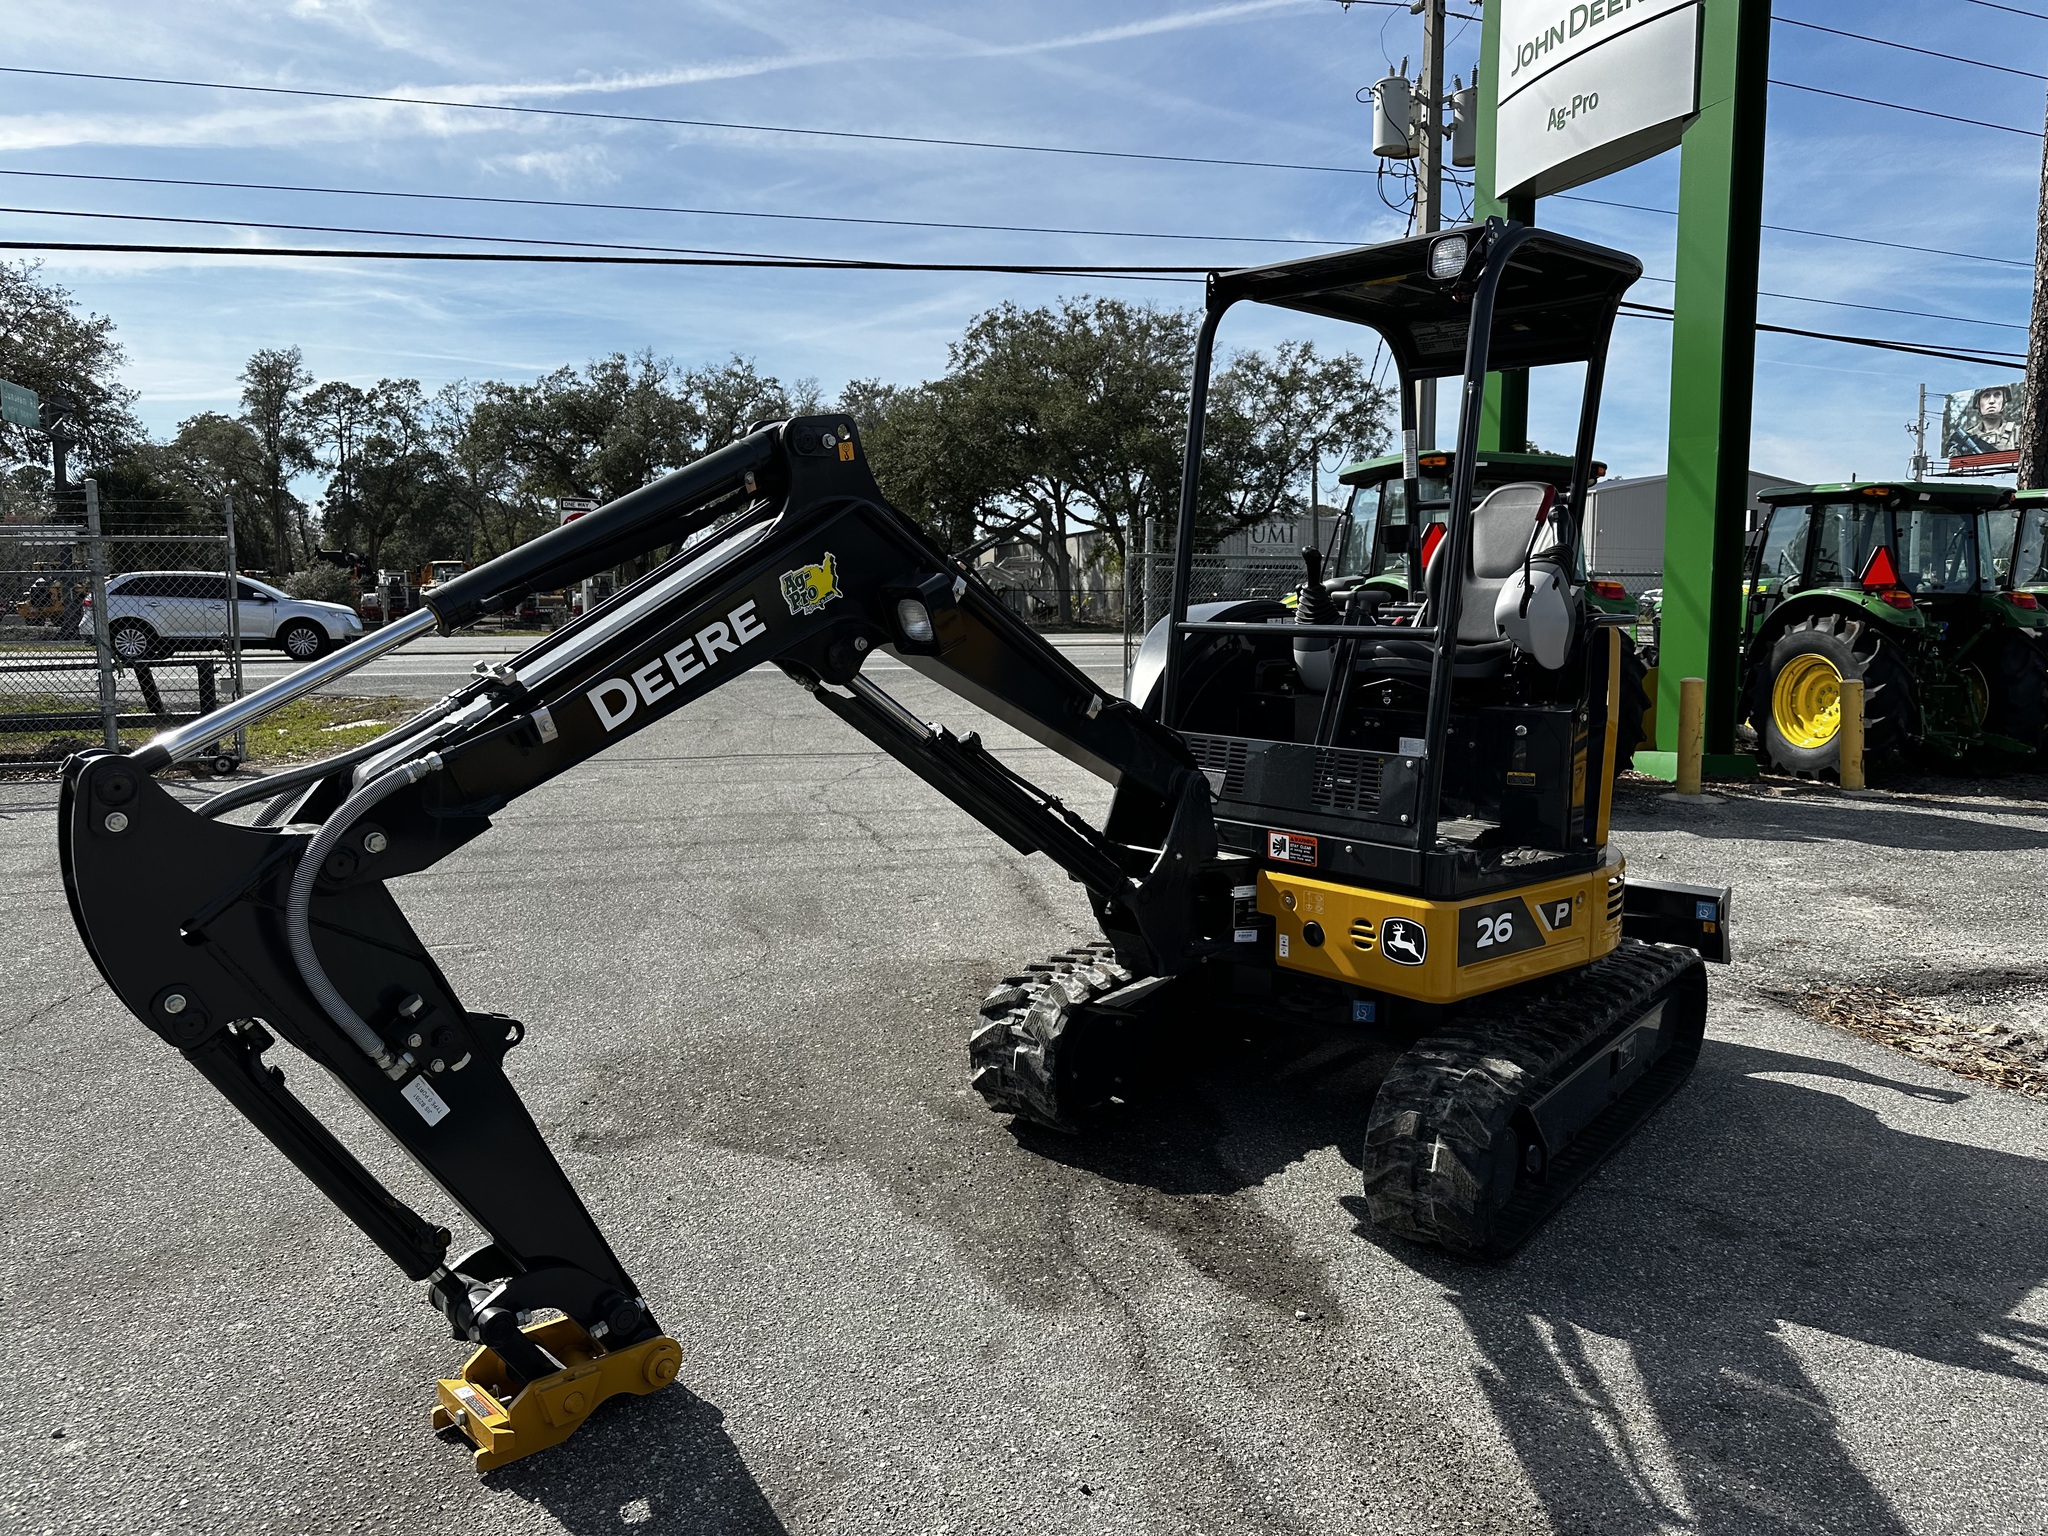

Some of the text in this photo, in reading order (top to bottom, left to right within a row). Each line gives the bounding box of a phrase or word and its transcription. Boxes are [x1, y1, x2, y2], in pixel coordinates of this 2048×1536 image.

[1511, 20, 1565, 77] JOHN
[1547, 92, 1599, 132] Ag-Pro
[1252, 525, 1294, 543] UMI
[586, 599, 767, 732] DEERE
[1554, 902, 1570, 927] P
[1476, 912, 1513, 948] 26
[414, 1082, 430, 1100] PORTS
[424, 1105, 433, 1115] JIS
[430, 1100, 443, 1114] TYPE
